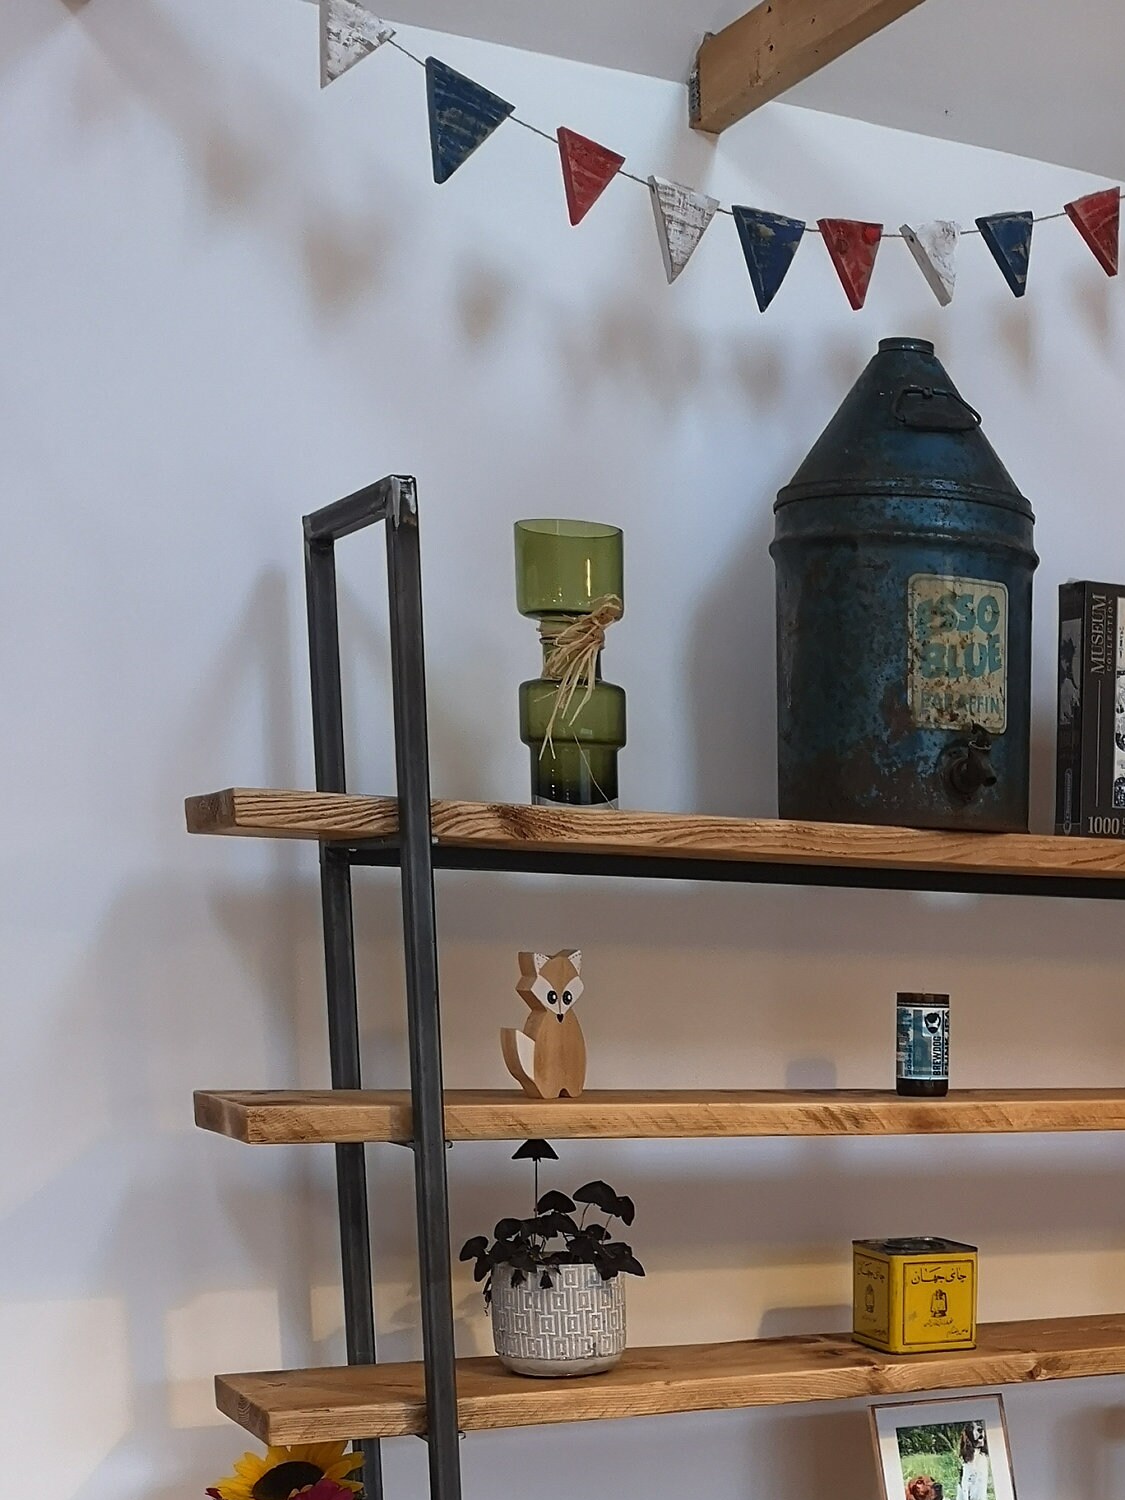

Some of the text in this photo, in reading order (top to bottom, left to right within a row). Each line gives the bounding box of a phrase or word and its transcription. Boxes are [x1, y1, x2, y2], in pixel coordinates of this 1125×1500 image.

[916, 593, 1000, 640] ESSO
[1090, 593, 1107, 675] MUSEUM
[920, 633, 1002, 679] BLUE
[1087, 816, 1120, 835] 1000
[932, 1035, 942, 1076] BREWDOG
